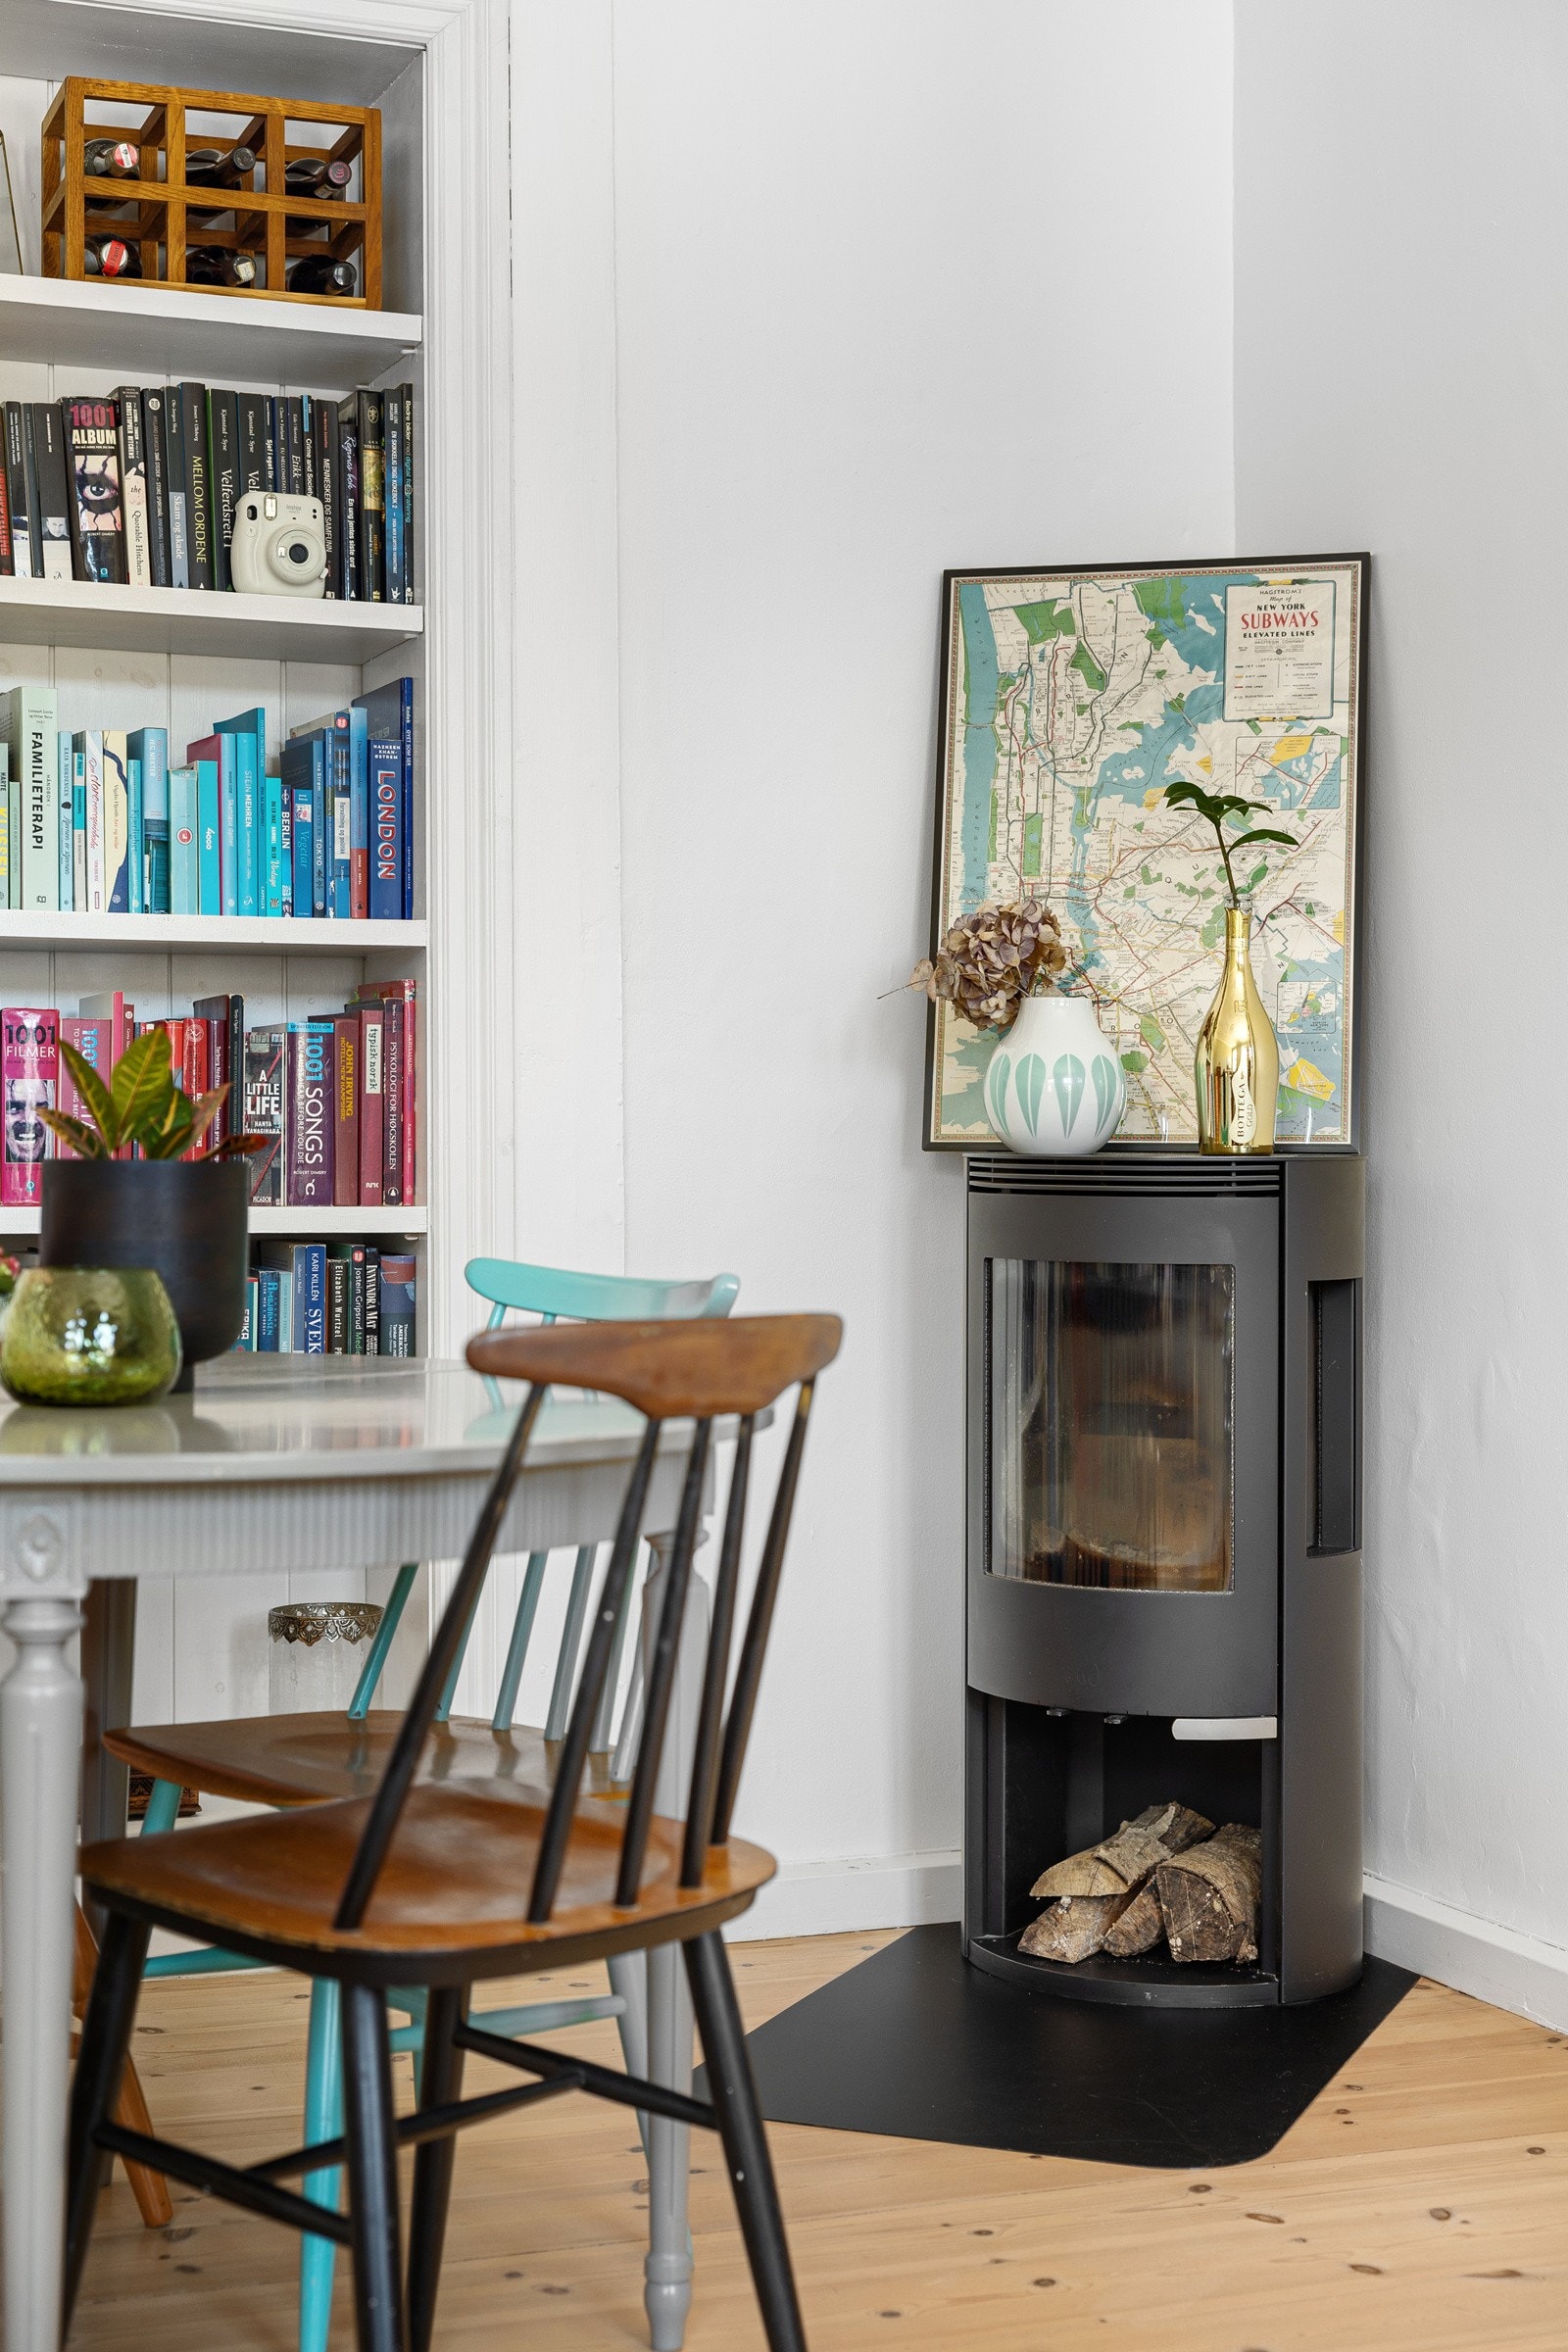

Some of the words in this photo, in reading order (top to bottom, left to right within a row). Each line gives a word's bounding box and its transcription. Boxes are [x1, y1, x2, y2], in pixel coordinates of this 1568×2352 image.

[70, 404, 116, 427] 1001
[72, 428, 117, 445] ALBUM
[291, 455, 301, 478] Etikk
[341, 436, 357, 471] Regines
[130, 485, 142, 494] the
[192, 456, 204, 509] MELLOM
[305, 471, 314, 497] Society
[322, 459, 331, 503] MENNESKER
[347, 473, 358, 490] bok
[173, 496, 182, 519] Skam
[221, 468, 233, 540] Velferdsrett
[324, 505, 331, 515] OG
[348, 498, 355, 507] En
[132, 510, 142, 543] Quotable
[173, 521, 182, 533] og
[194, 512, 207, 564] ORDENE
[347, 519, 356, 540] jentes
[135, 544, 144, 576] Hitchens
[174, 534, 184, 560] skade
[1241, 611, 1319, 630] SUBWAYS
[88, 758, 99, 774] Den
[31, 731, 43, 850] FAMILIETERAPI
[90, 774, 101, 803] store
[244, 770, 253, 793] STEIN
[128, 809, 140, 853] Kjærlighet
[281, 811, 291, 850] BERLIN
[377, 769, 396, 880] LONDON
[63, 849, 72, 875] stjernen
[297, 830, 310, 869] Vegetar
[269, 859, 280, 888] Vintage
[5, 1024, 56, 1045] 1001
[73, 1027, 80, 1038] TO
[368, 1028, 378, 1059] typisk
[6, 1046, 56, 1058] FILMER
[305, 1035, 323, 1081] 1001
[345, 1041, 354, 1074] JOHN
[247, 1082, 280, 1096] LITTLE
[259, 1069, 268, 1082] A
[369, 1060, 378, 1090] norsk
[247, 1096, 280, 1115] LIFE
[345, 1076, 354, 1116] IRVING
[1237, 1083, 1246, 1137] BOTTEGA
[305, 1087, 324, 1164] SONGS
[388, 1113, 397, 1170] HØGSKOLEN
[311, 1252, 319, 1272] KARI
[311, 1273, 319, 1301] KILLÉN
[334, 1265, 344, 1303] Elizabeth
[354, 1267, 363, 1295] Jostein
[366, 1264, 378, 1310] INNVANDRA
[267, 1282, 278, 1336] AMBJØRNSEN
[334, 1306, 343, 1338] Wurtzel
[353, 1296, 363, 1330] Gripsrud
[366, 1310, 378, 1330] MAT
[393, 1340, 397, 1348] om
